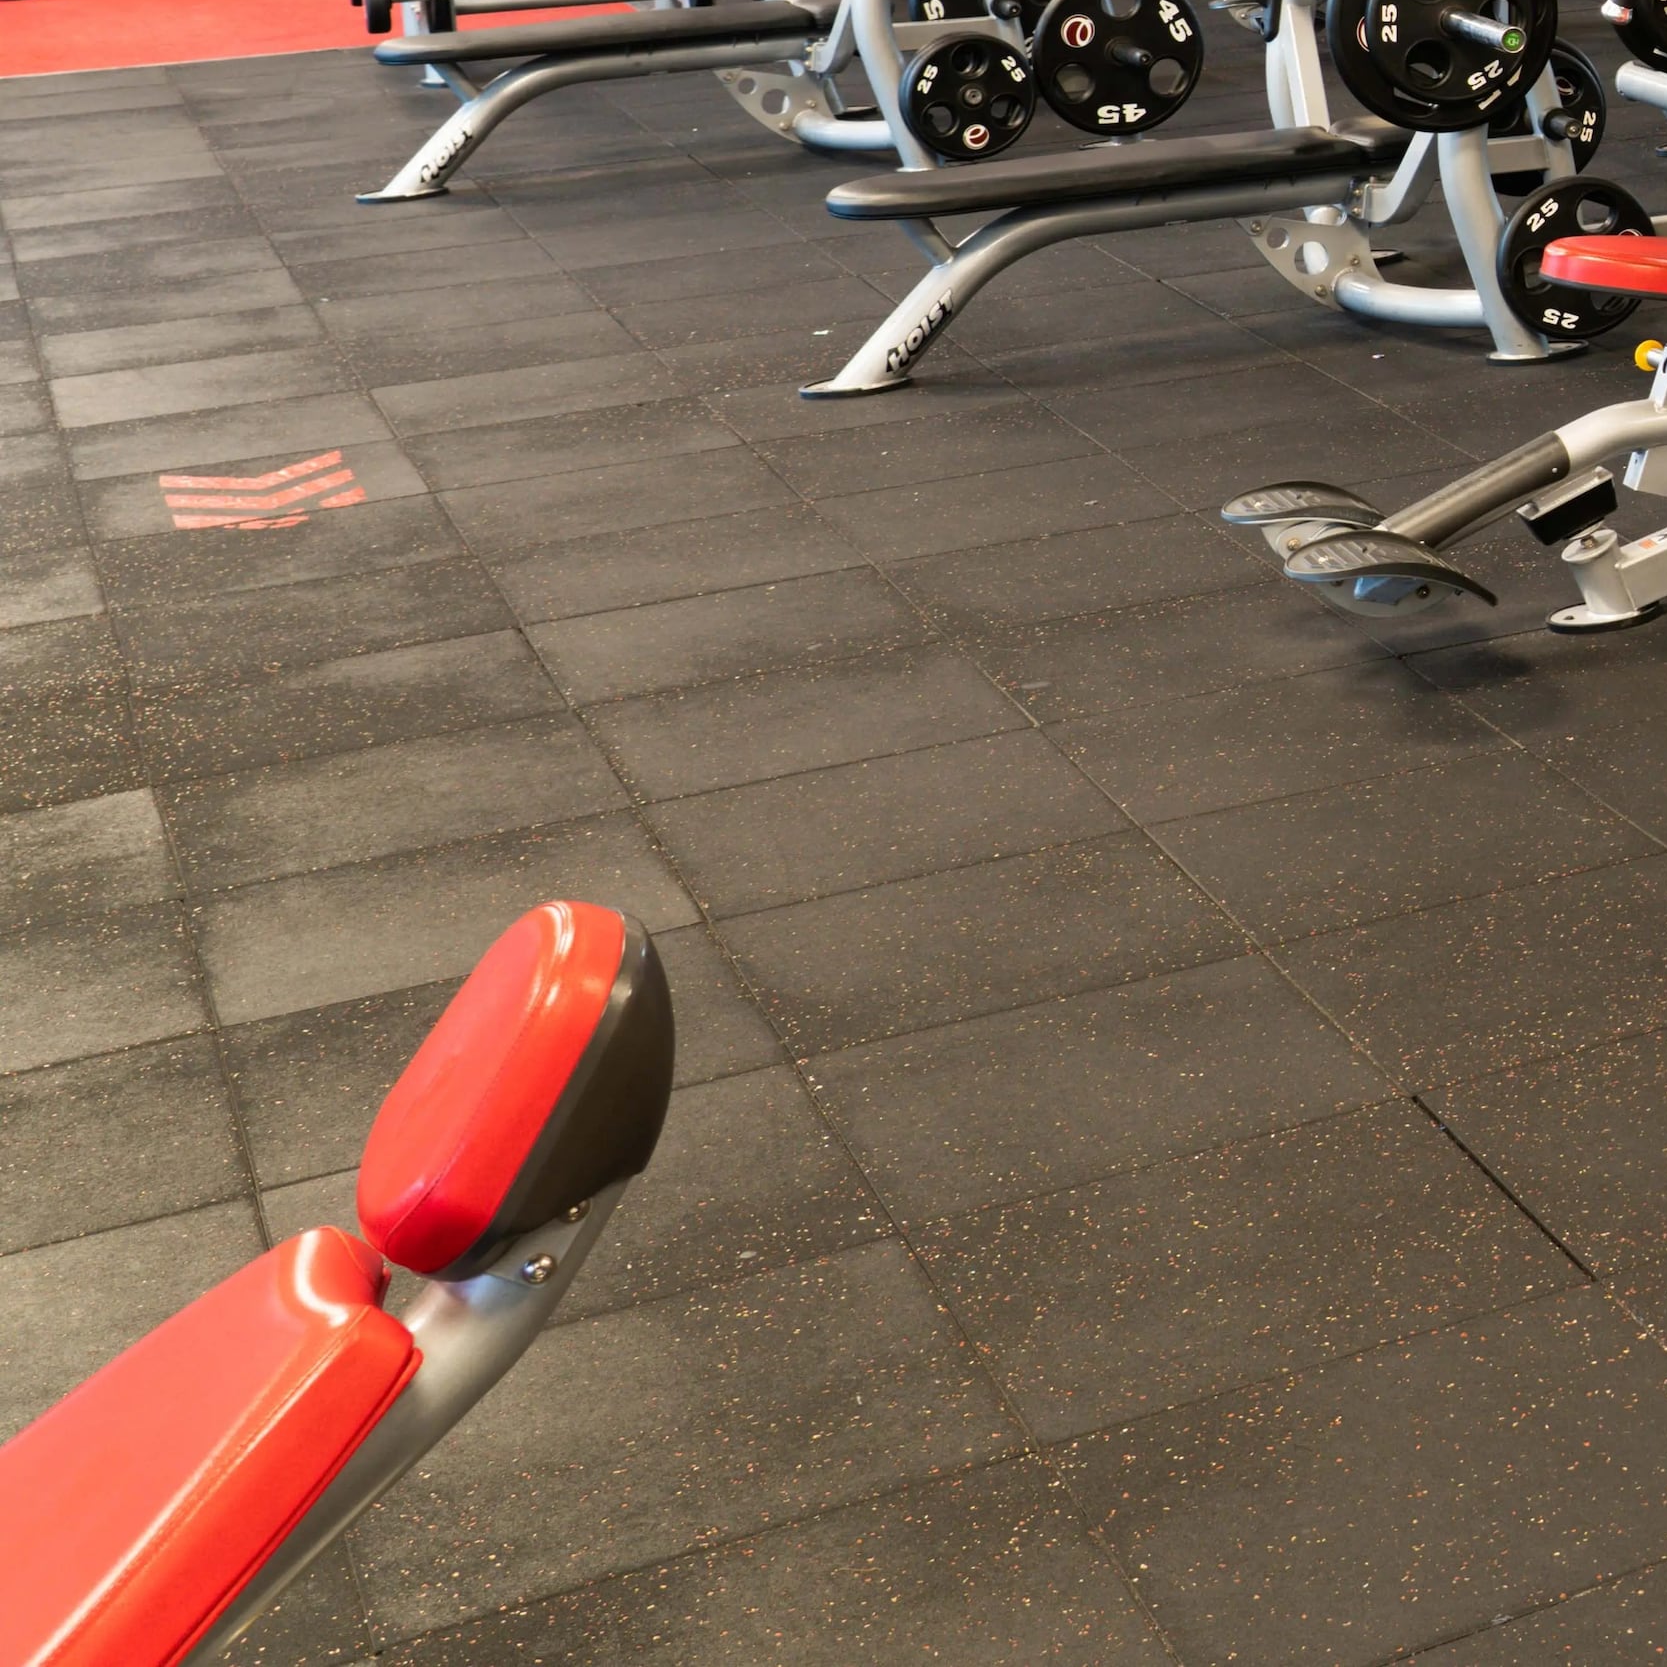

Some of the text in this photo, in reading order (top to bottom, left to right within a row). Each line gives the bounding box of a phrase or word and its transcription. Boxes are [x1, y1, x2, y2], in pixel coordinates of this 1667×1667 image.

[1381, 3, 1398, 43] 25
[917, 64, 939, 95] 25
[1000, 55, 1027, 83] 25
[1467, 59, 1504, 91] 25
[1097, 103, 1147, 124] 45
[1580, 110, 1597, 143] 25
[1526, 198, 1560, 232] 25
[886, 287, 953, 374] HOIST
[1542, 308, 1580, 330] 25
